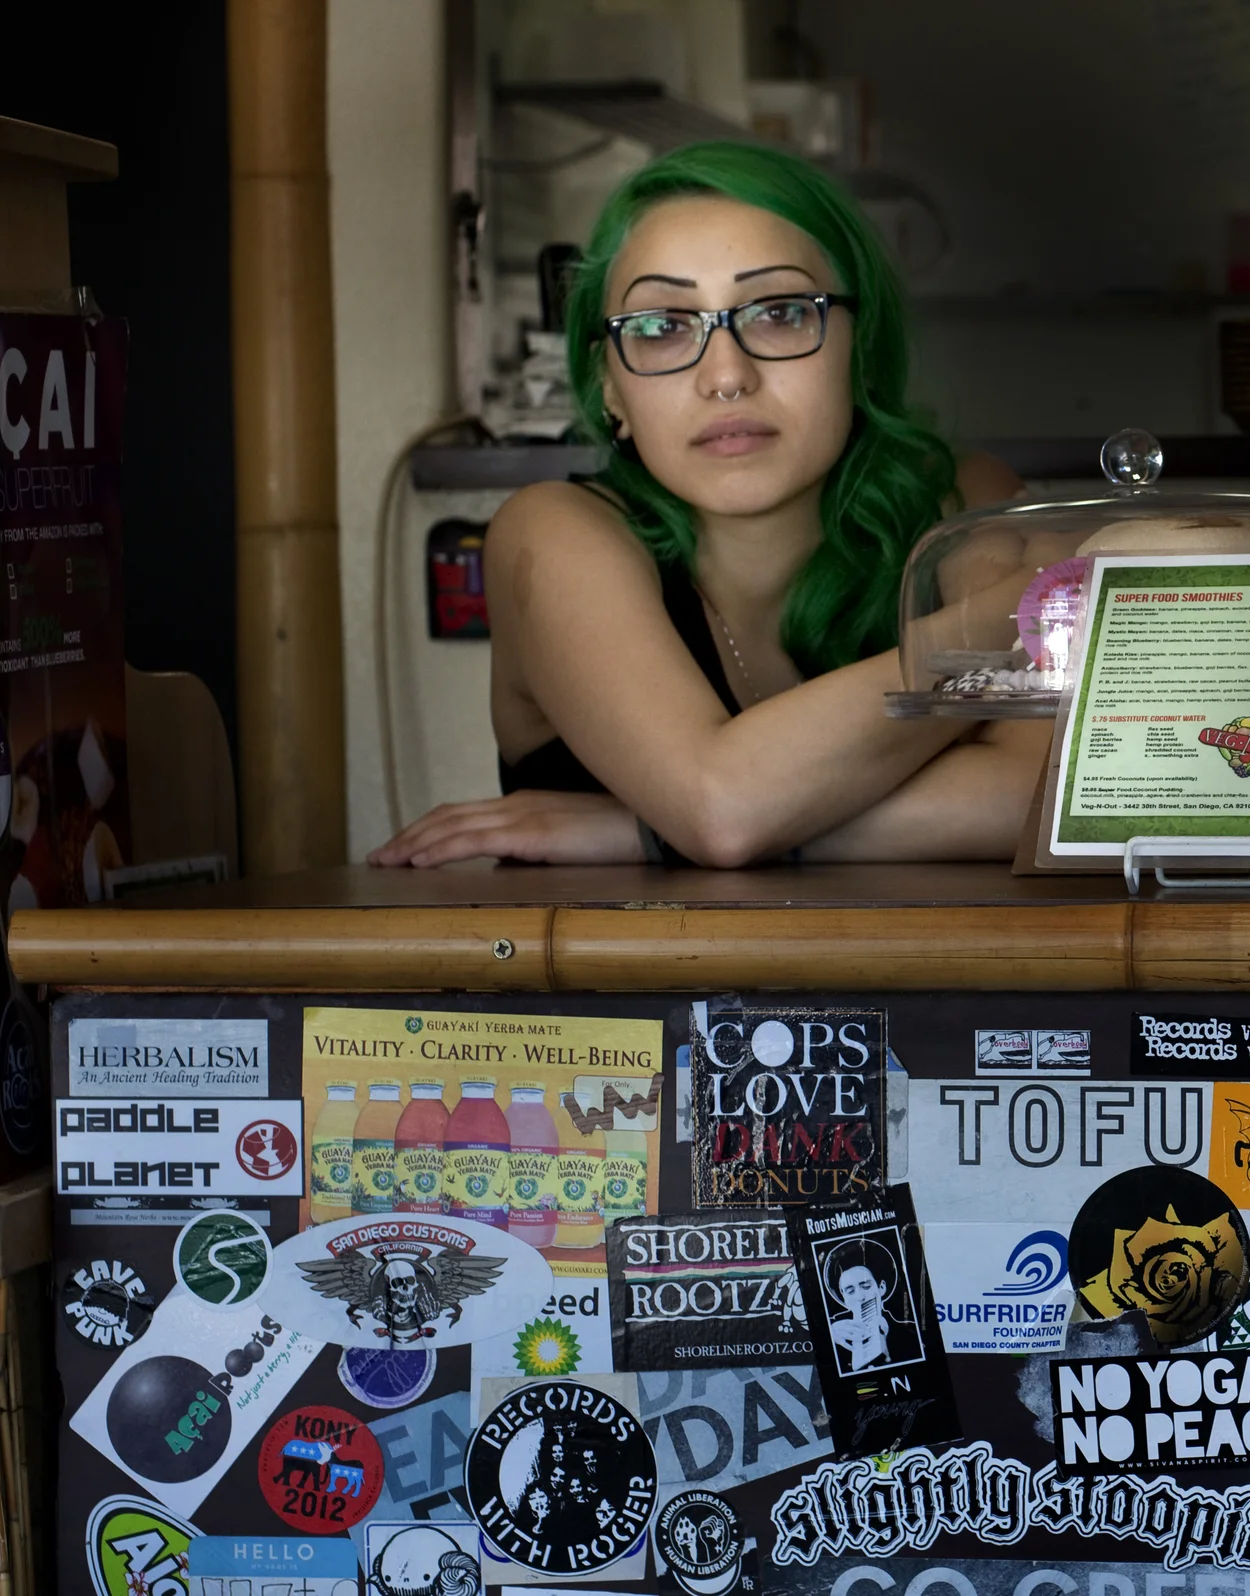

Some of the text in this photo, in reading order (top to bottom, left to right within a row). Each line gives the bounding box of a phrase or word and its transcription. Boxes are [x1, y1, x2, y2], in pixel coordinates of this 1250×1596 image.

[1114, 593, 1149, 603] SUPER
[1152, 592, 1179, 603] FOOD
[1181, 592, 1243, 603] SMOOTHIES
[1109, 715, 1149, 723] SUBSTITUTE
[1150, 714, 1181, 722] COCONUT
[1183, 714, 1206, 722] WATER
[1205, 729, 1239, 748] VEG
[427, 1018, 562, 1036] GUAYAKÍ YERBA MATE
[1140, 1015, 1232, 1041] Records
[78, 1045, 260, 1069] HERBALISM
[314, 1034, 652, 1069] VITALITY CLARITY WELL-BEING
[705, 1020, 870, 1070] COPS
[1146, 1036, 1237, 1061] Records
[78, 1071, 260, 1088] An Ancient Healing Tradition
[601, 1080, 615, 1089] For
[709, 1072, 869, 1116] LOVE
[712, 1121, 866, 1162] DANK
[939, 1084, 1204, 1168] TOFU
[711, 1168, 871, 1195] DONUTS
[332, 1223, 469, 1253] SAN DIEGO CUSTOMS
[377, 1243, 424, 1254] CALIFORNIA
[631, 1279, 773, 1318] ROOTZ
[934, 1302, 1067, 1324] SURFRIDER
[65, 1301, 135, 1347] PUNK
[992, 1325, 1063, 1339] FOUNDATION
[674, 1340, 814, 1359] SHORELINEROOTZ.CO
[952, 1339, 1061, 1349] SAN DIEGO COUNTY CHAPTER
[236, 1392, 252, 1411] Not
[249, 1374, 266, 1400] just
[1057, 1363, 1132, 1414] NO
[294, 1414, 359, 1446] KONY
[481, 1385, 637, 1451] RECORDS
[1061, 1413, 1135, 1465] NO
[282, 1488, 348, 1522] 2012
[660, 1493, 738, 1530] ANIMAL LIBERATION
[772, 1441, 1030, 1566] slightly
[479, 1475, 653, 1570] WITH ROGER
[233, 1543, 316, 1561] HELLO
[664, 1540, 739, 1575] HUMAN LIBERATION
